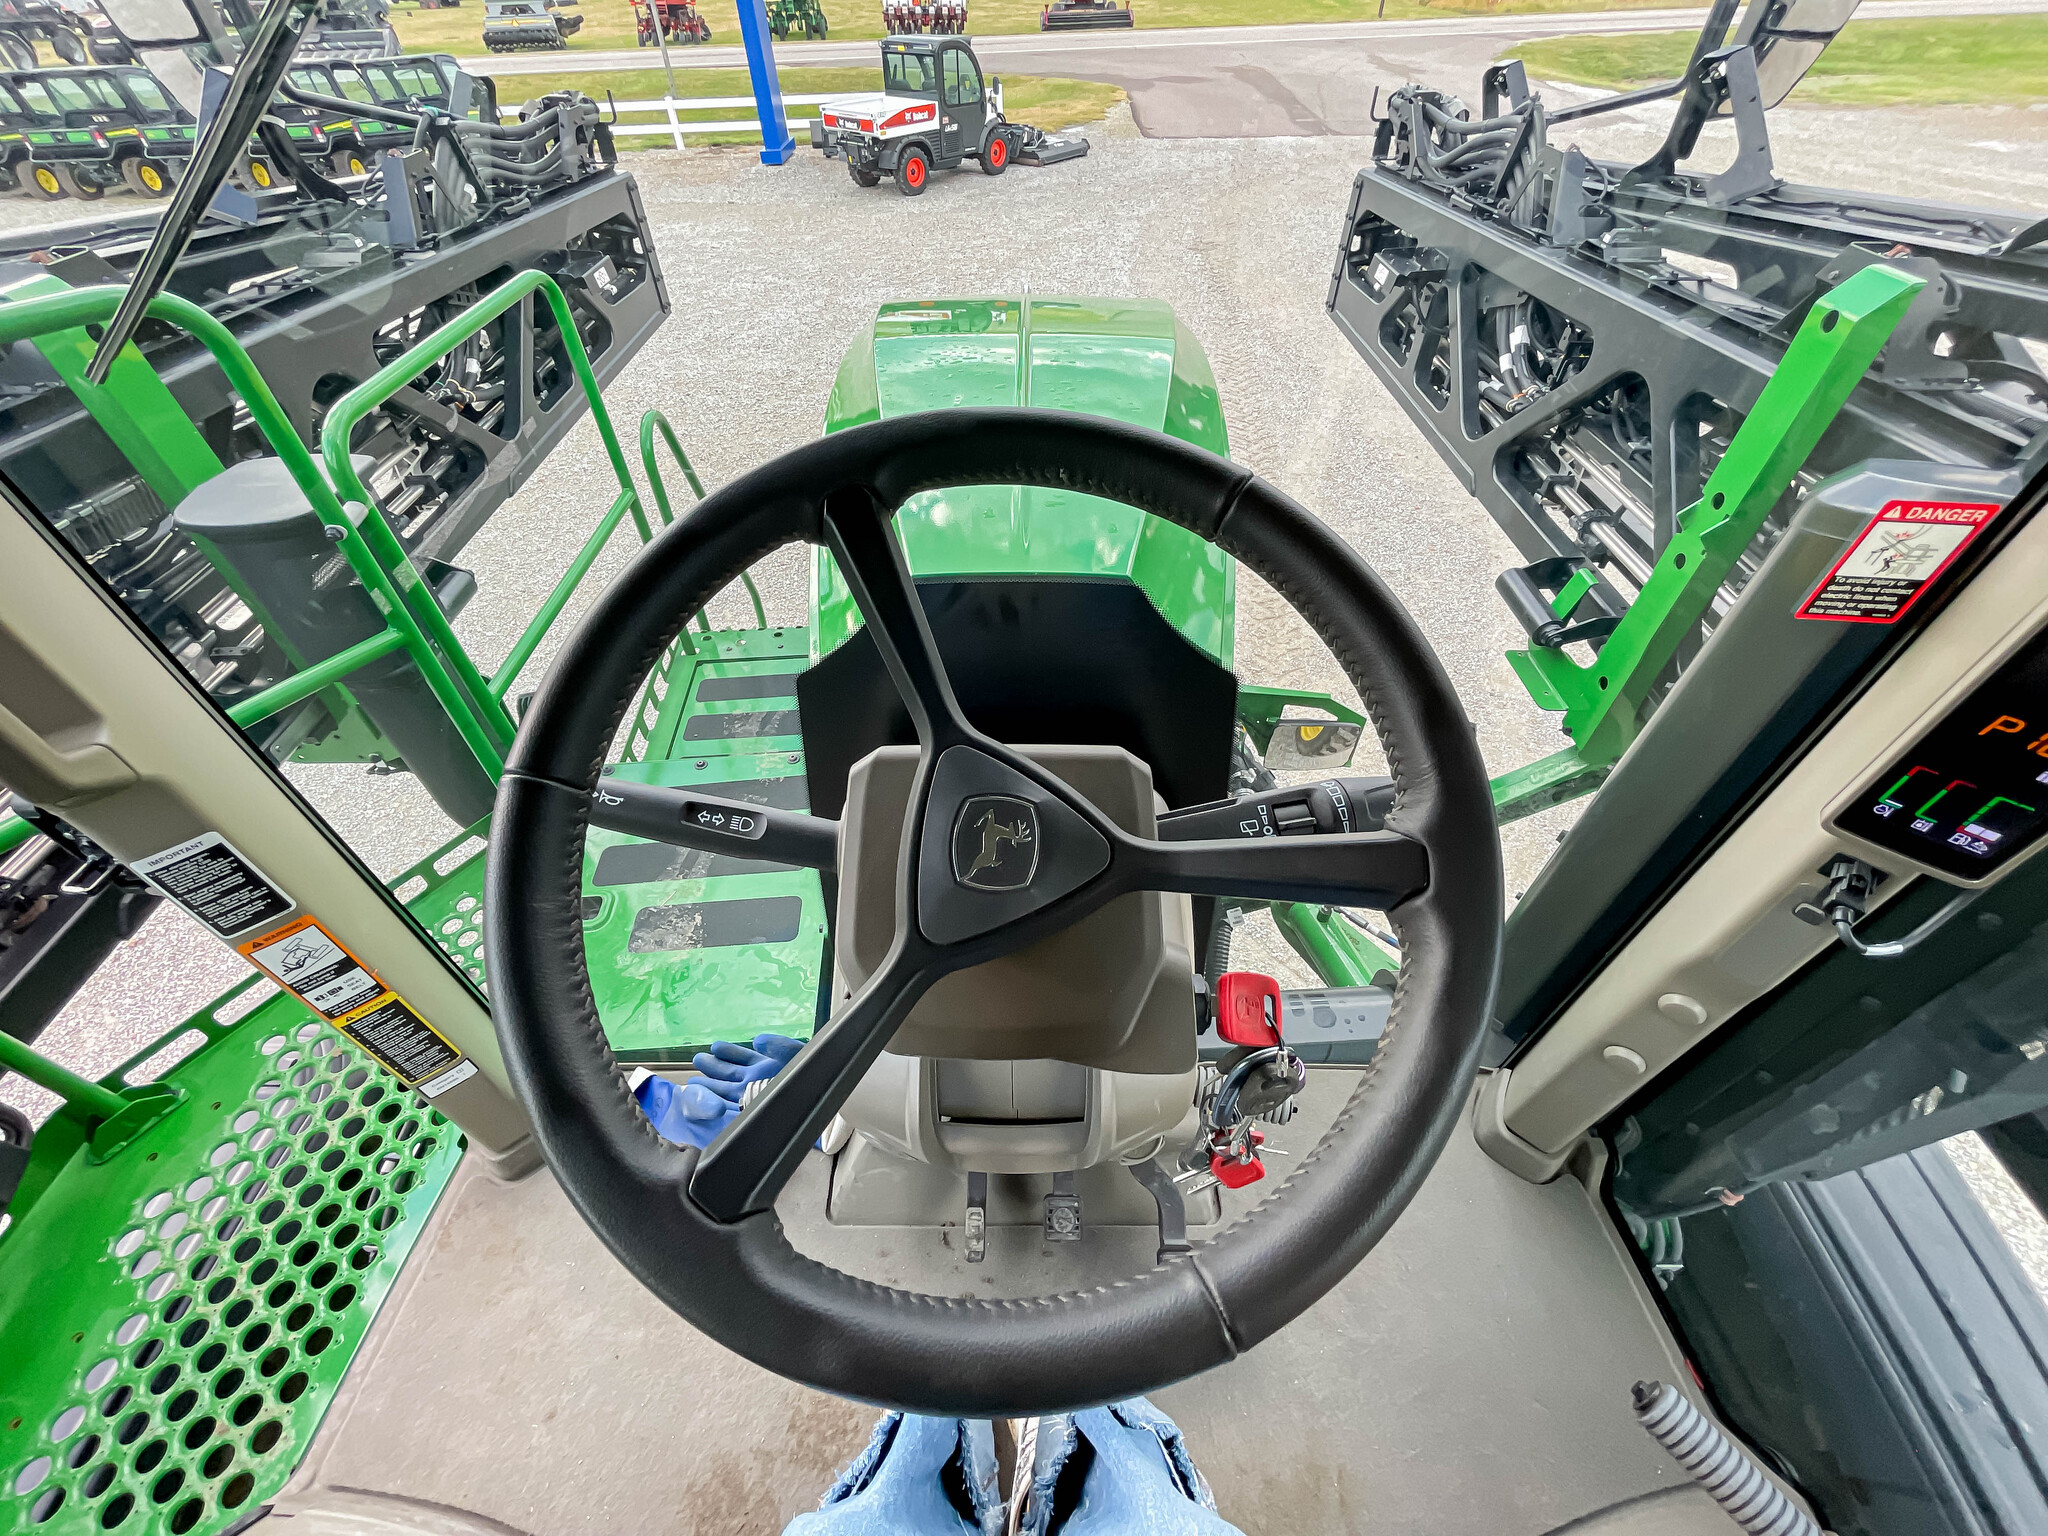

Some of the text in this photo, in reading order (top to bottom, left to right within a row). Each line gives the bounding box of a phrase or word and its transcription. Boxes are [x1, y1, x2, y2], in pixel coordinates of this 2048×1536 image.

[1904, 506, 1989, 523] DANGER
[147, 840, 204, 867] IMPORTANT
[262, 921, 303, 942] WARNING
[356, 999, 387, 1016] CAUTION
